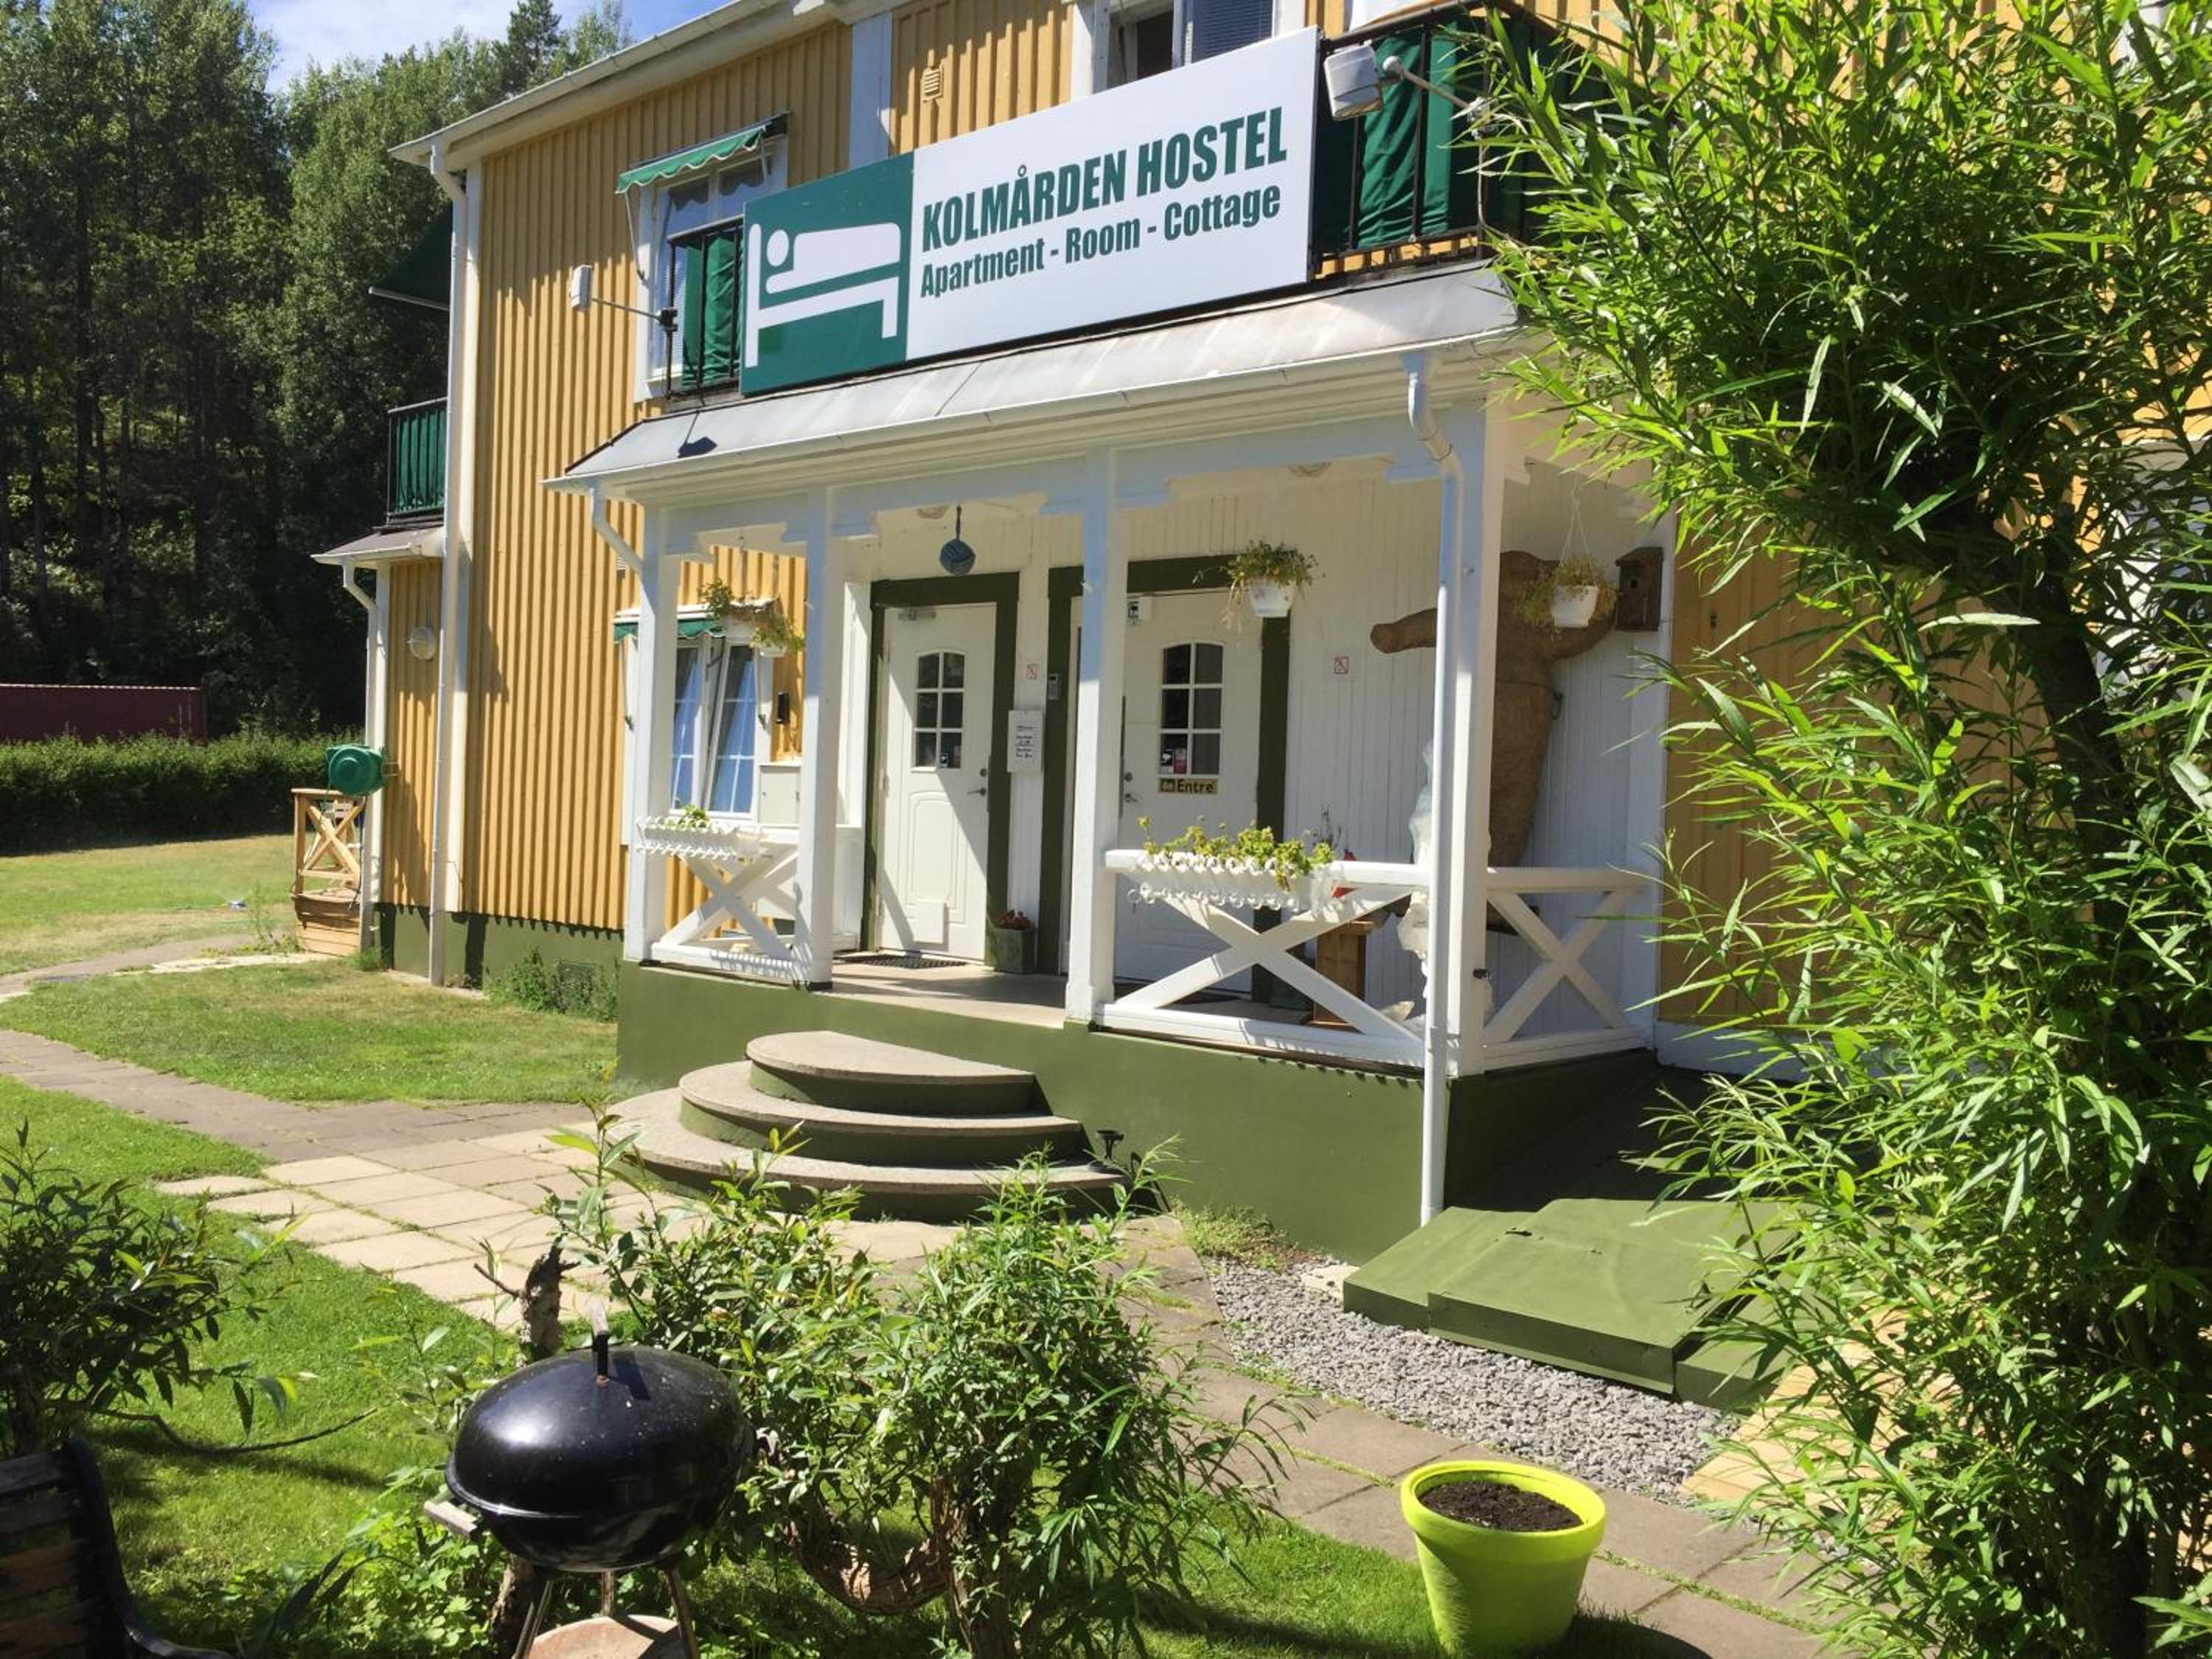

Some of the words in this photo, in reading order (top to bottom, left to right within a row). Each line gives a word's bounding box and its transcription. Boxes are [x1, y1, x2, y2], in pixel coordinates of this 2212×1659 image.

[920, 237, 1045, 298] Apartment
[1065, 218, 1141, 264] Room
[1164, 185, 1281, 241] Cottage
[922, 149, 1127, 252] KOLMÅRDEN
[1136, 106, 1287, 198] HOSTEL
